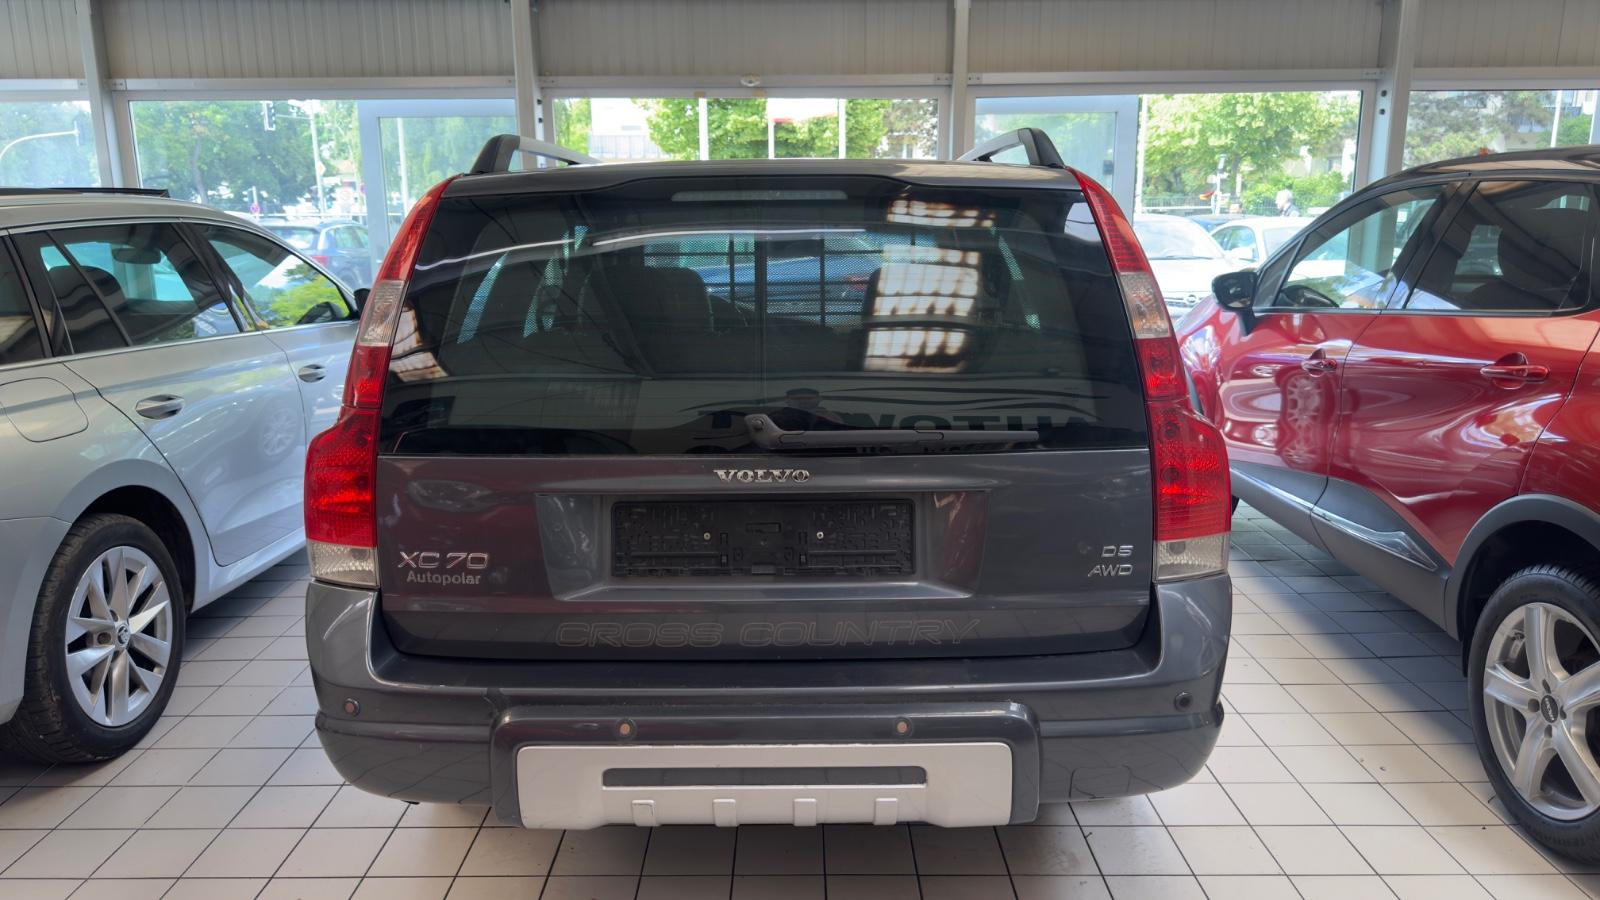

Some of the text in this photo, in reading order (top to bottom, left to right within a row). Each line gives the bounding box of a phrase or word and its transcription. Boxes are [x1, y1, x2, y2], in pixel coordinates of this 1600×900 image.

[713, 469, 810, 483] VOLVO
[1101, 545, 1134, 558] D5
[398, 551, 489, 570] XC 70
[406, 570, 481, 586] Autopolar
[1088, 564, 1133, 577] AWD
[555, 618, 981, 648] CROSS COUNTRY
